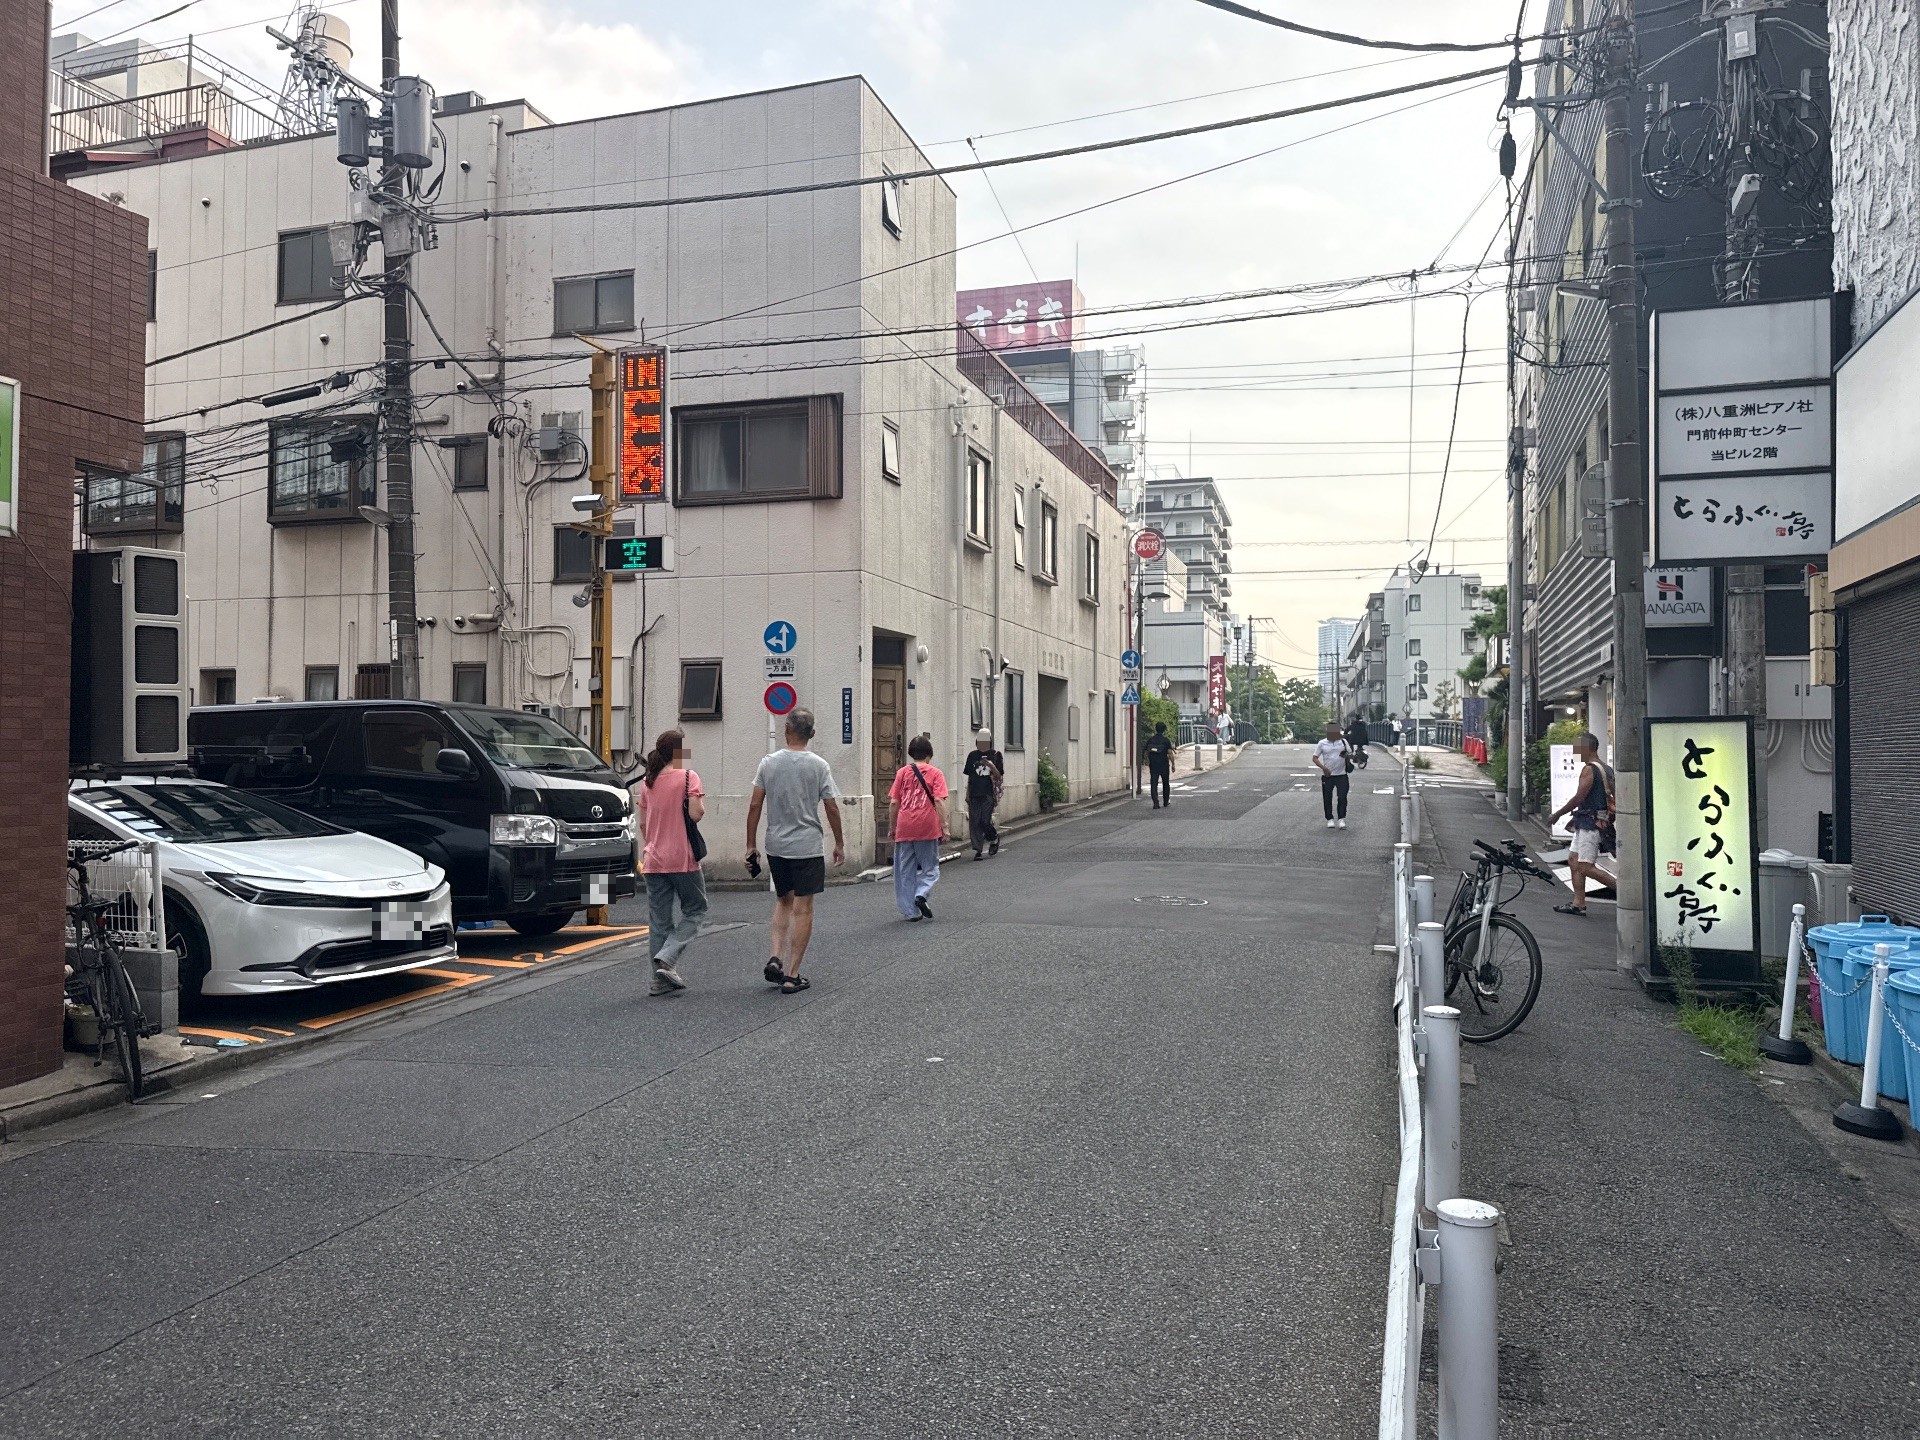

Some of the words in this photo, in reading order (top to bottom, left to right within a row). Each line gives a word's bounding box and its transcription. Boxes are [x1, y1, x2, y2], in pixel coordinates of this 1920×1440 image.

[1675, 399, 1814, 421] (株)八重洲ピアノ社
[1687, 424, 1802, 441] 門前仲町センター
[1711, 446, 1778, 461] 当ビル2階
[1673, 495, 1814, 540] とらふぐ亭
[623, 539, 647, 568] 空
[1137, 540, 1159, 551] 消火栓
[1645, 602, 1706, 615] ANAGATA
[766, 658, 795, 666] 自転車を除く
[766, 665, 795, 673] 一方通行
[1664, 738, 1741, 933] とらふぐ亭
